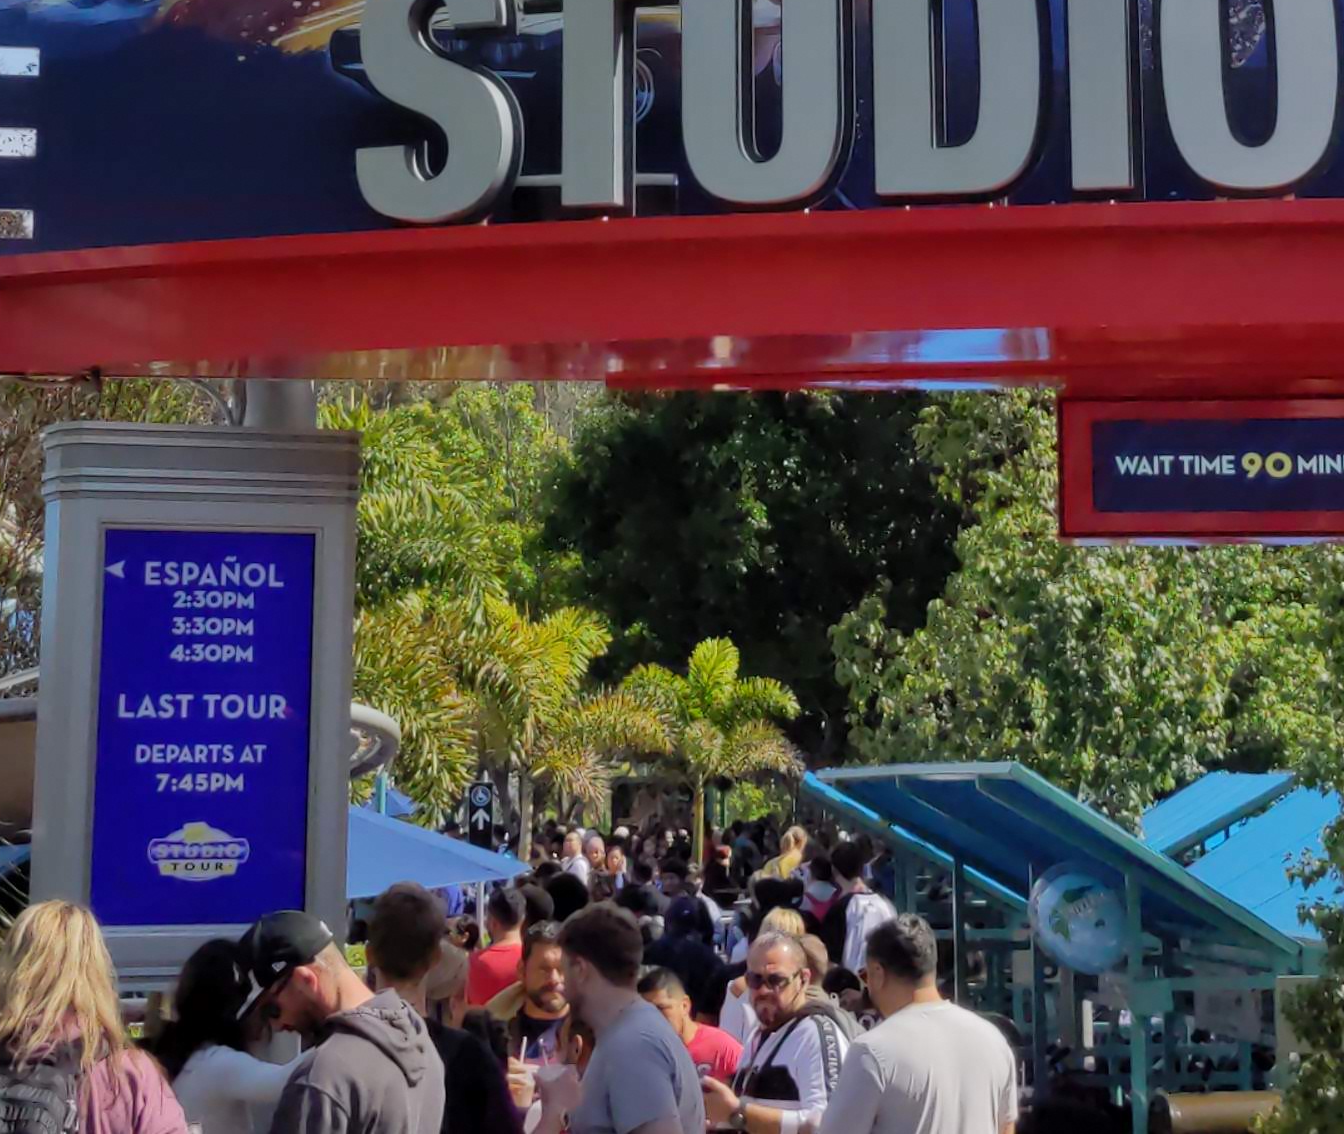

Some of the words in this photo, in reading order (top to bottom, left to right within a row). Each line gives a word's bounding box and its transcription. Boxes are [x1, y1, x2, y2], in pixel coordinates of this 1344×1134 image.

[1115, 455, 1174, 476] WAIT
[1179, 455, 1236, 476] TIME
[1241, 452, 1292, 479] 90
[144, 556, 284, 588] ESPAÑOL
[173, 591, 255, 610] 2:30PM
[171, 617, 254, 636] 3:30PM
[169, 644, 254, 663] 4:30PM
[118, 694, 194, 719] LAST
[203, 694, 287, 719] TOUR
[135, 744, 234, 764] DEPARTS
[239, 745, 267, 764] AT
[156, 773, 244, 792] 7:45PM
[156, 842, 241, 859] STUDIO
[171, 862, 224, 871] TOUR
